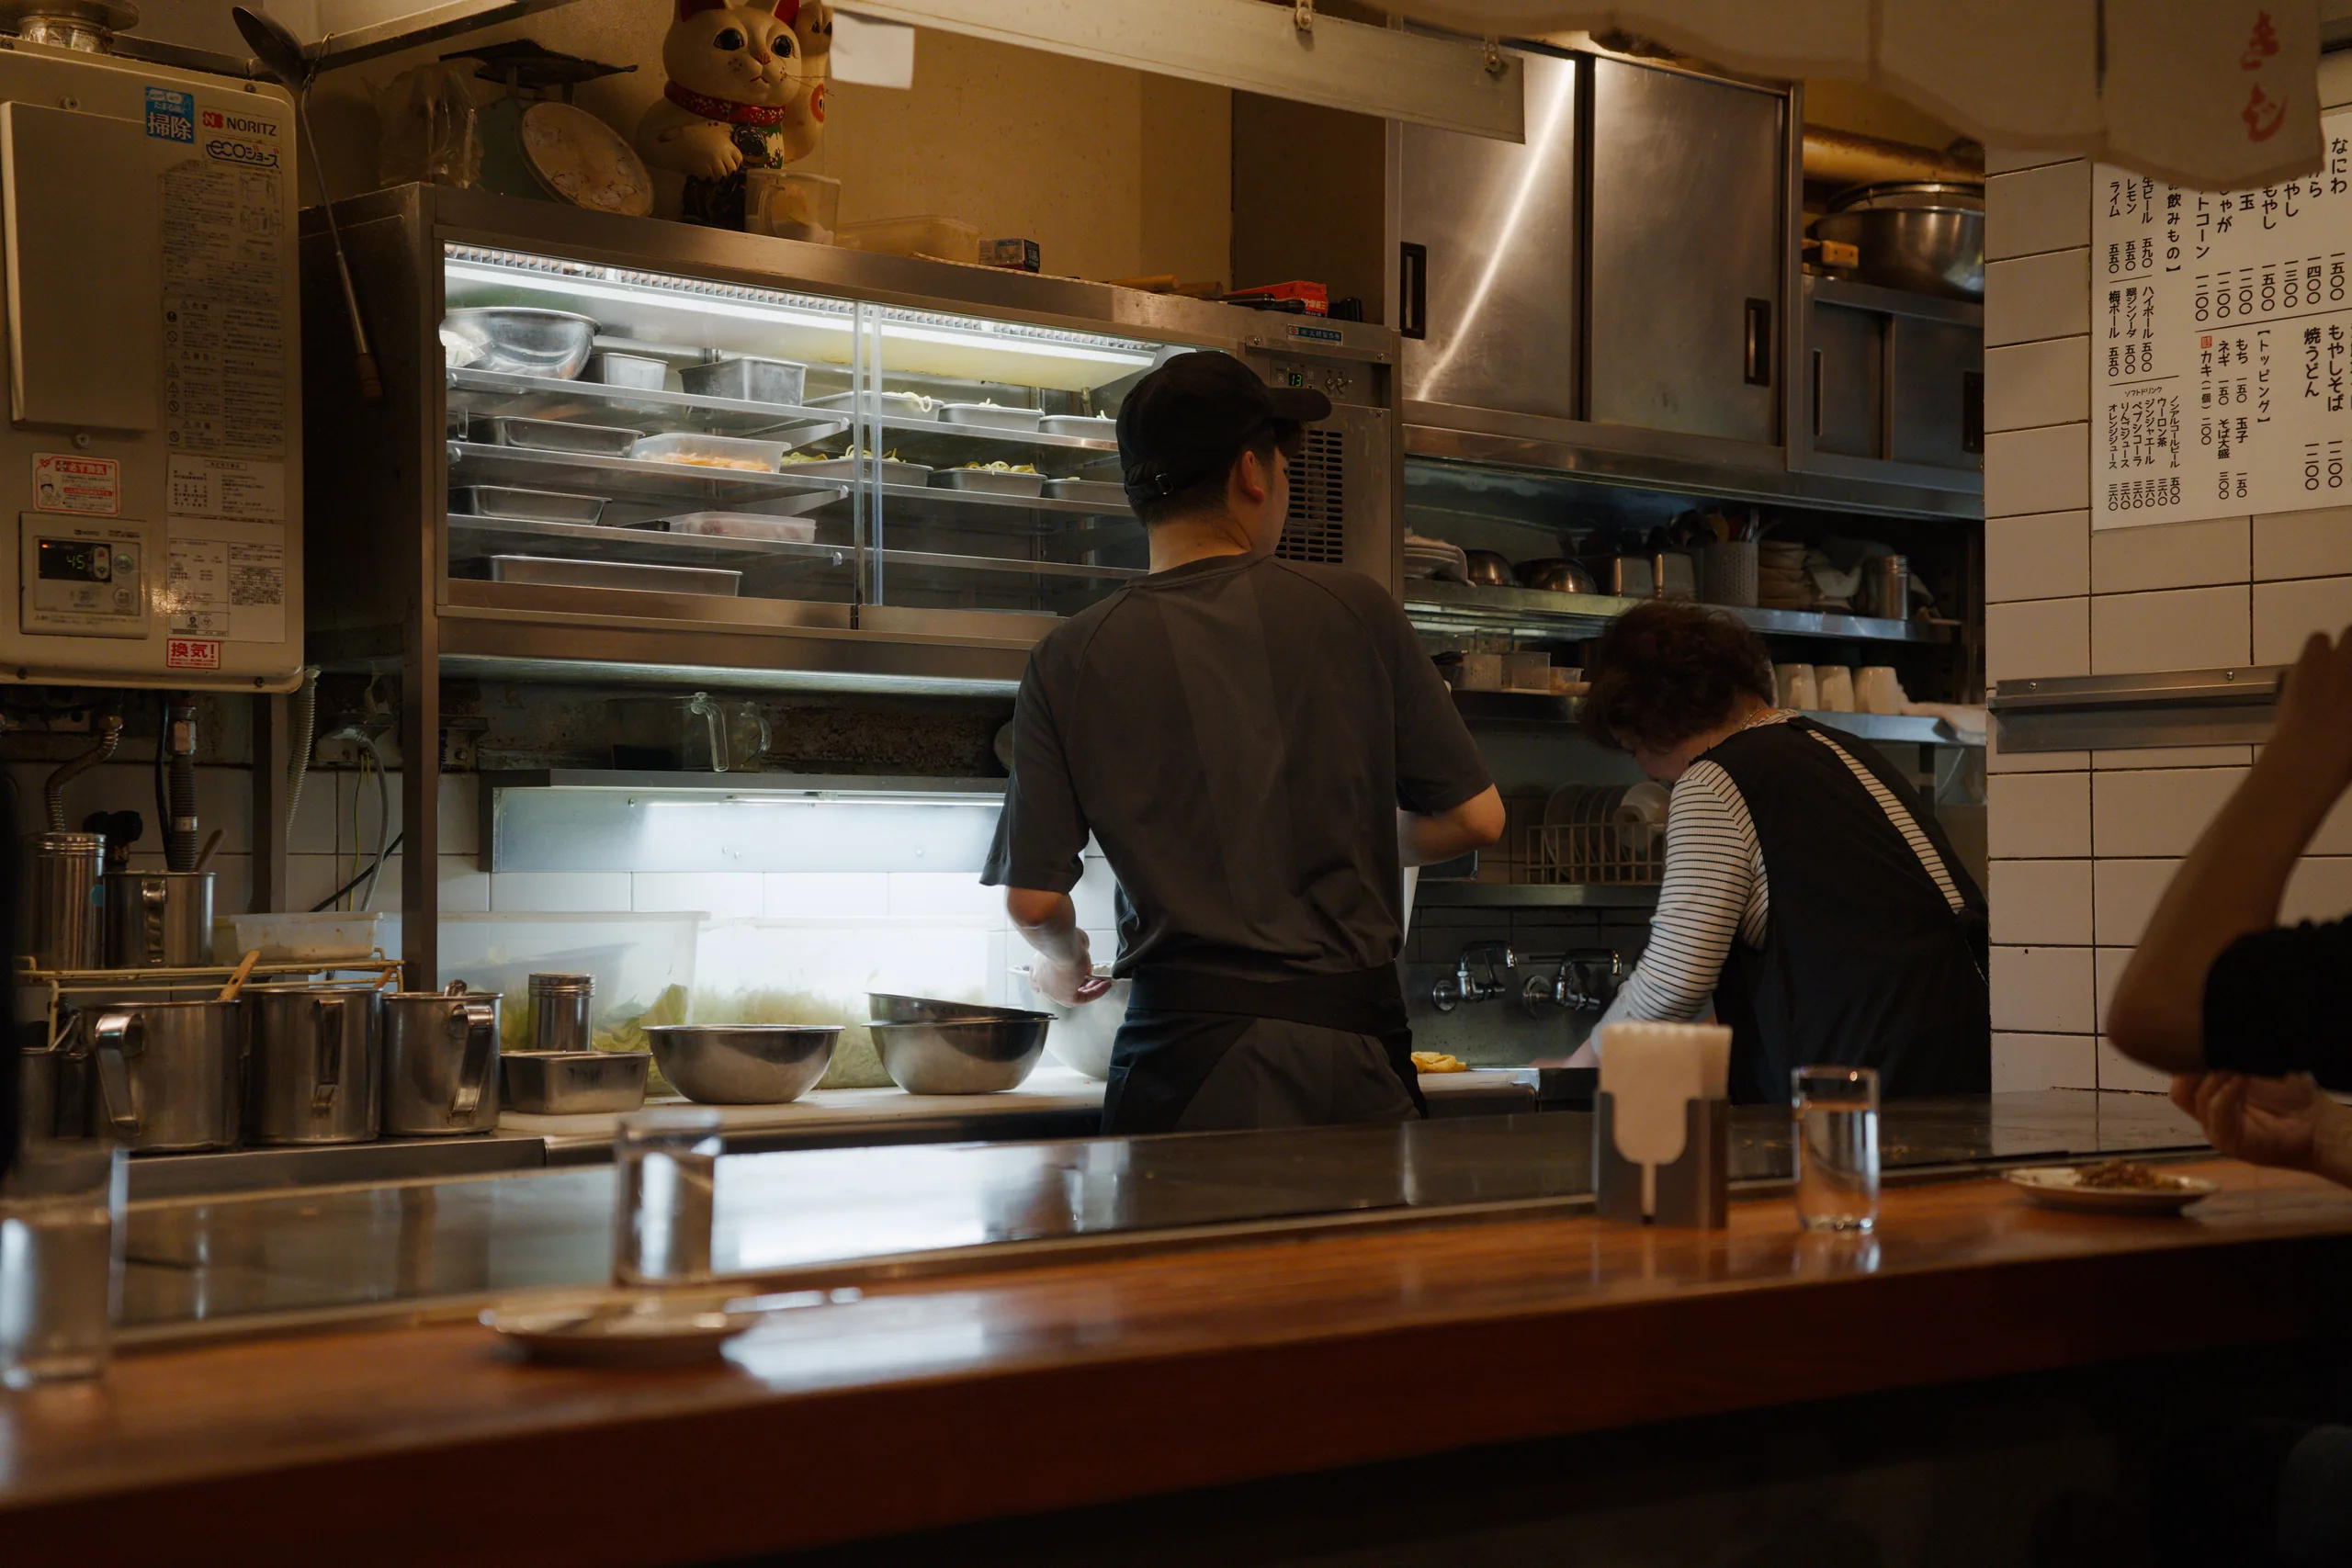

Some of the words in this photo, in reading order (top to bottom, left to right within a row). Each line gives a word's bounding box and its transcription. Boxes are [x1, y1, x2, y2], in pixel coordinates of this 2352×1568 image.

[148, 111, 192, 141] 掃除
[227, 117, 277, 137] NORITZ
[2331, 138, 2348, 194] なにわ
[2109, 181, 2120, 218] ライム
[2125, 177, 2138, 215] レモン
[2284, 178, 2301, 218] やし
[2307, 173, 2324, 199] ら
[2195, 190, 2211, 260] トコーン
[2109, 243, 2120, 274] 五五〇
[2125, 241, 2136, 271] 五五〇
[2142, 238, 2153, 268] 五九〇
[2239, 268, 2253, 314] 一二〇〇
[2261, 265, 2276, 311] 一五〇〇
[2284, 261, 2299, 308] 一三〇〇
[2307, 256, 2322, 304] 一四〇〇
[2330, 253, 2345, 300] 一五〇〇
[2196, 275, 2209, 321] 一二〇〇
[2217, 272, 2231, 318] 一二〇〇
[2143, 287, 2154, 339] ハイボール
[2109, 347, 2119, 377] 五五〇
[2125, 344, 2135, 374] 五〇〇
[2142, 342, 2152, 372] 五〇〇
[2218, 341, 2230, 367] ネギ
[2236, 339, 2248, 364] もち
[2304, 327, 2321, 398] 焼うどん
[2327, 325, 2344, 412] もやしそば
[2124, 387, 2163, 397] ソフトドリンク
[2219, 380, 2229, 405] 一五〇
[2236, 378, 2247, 403] 一五〇
[2257, 330, 2270, 423] 【トッピング】
[2109, 404, 2118, 469] オレンジジュース
[2120, 402, 2130, 468] りんごジュース
[2132, 401, 2143, 467] ペプシコーラ
[2144, 399, 2154, 465] ジンジャエール
[2157, 398, 2167, 447] ウーロン茶
[2170, 396, 2180, 468] ノンアルコールビール
[2201, 418, 2211, 445] 二〇〇
[2218, 419, 2230, 459] そば大盛
[2236, 417, 2248, 443] 玉子
[2305, 444, 2319, 491] 一二〇〇
[2328, 441, 2343, 488] 一二〇〇
[2109, 484, 2118, 511] 三六〇
[2120, 482, 2131, 510] 三六〇
[2133, 481, 2143, 508] 三六〇
[2145, 479, 2155, 507] 三六〇
[2158, 479, 2167, 506] 三六〇
[2170, 477, 2180, 504] 五〇〇
[2219, 472, 2229, 500] 三〇〇
[2236, 473, 2247, 498] 一五〇
[66, 555, 85, 570] 45
